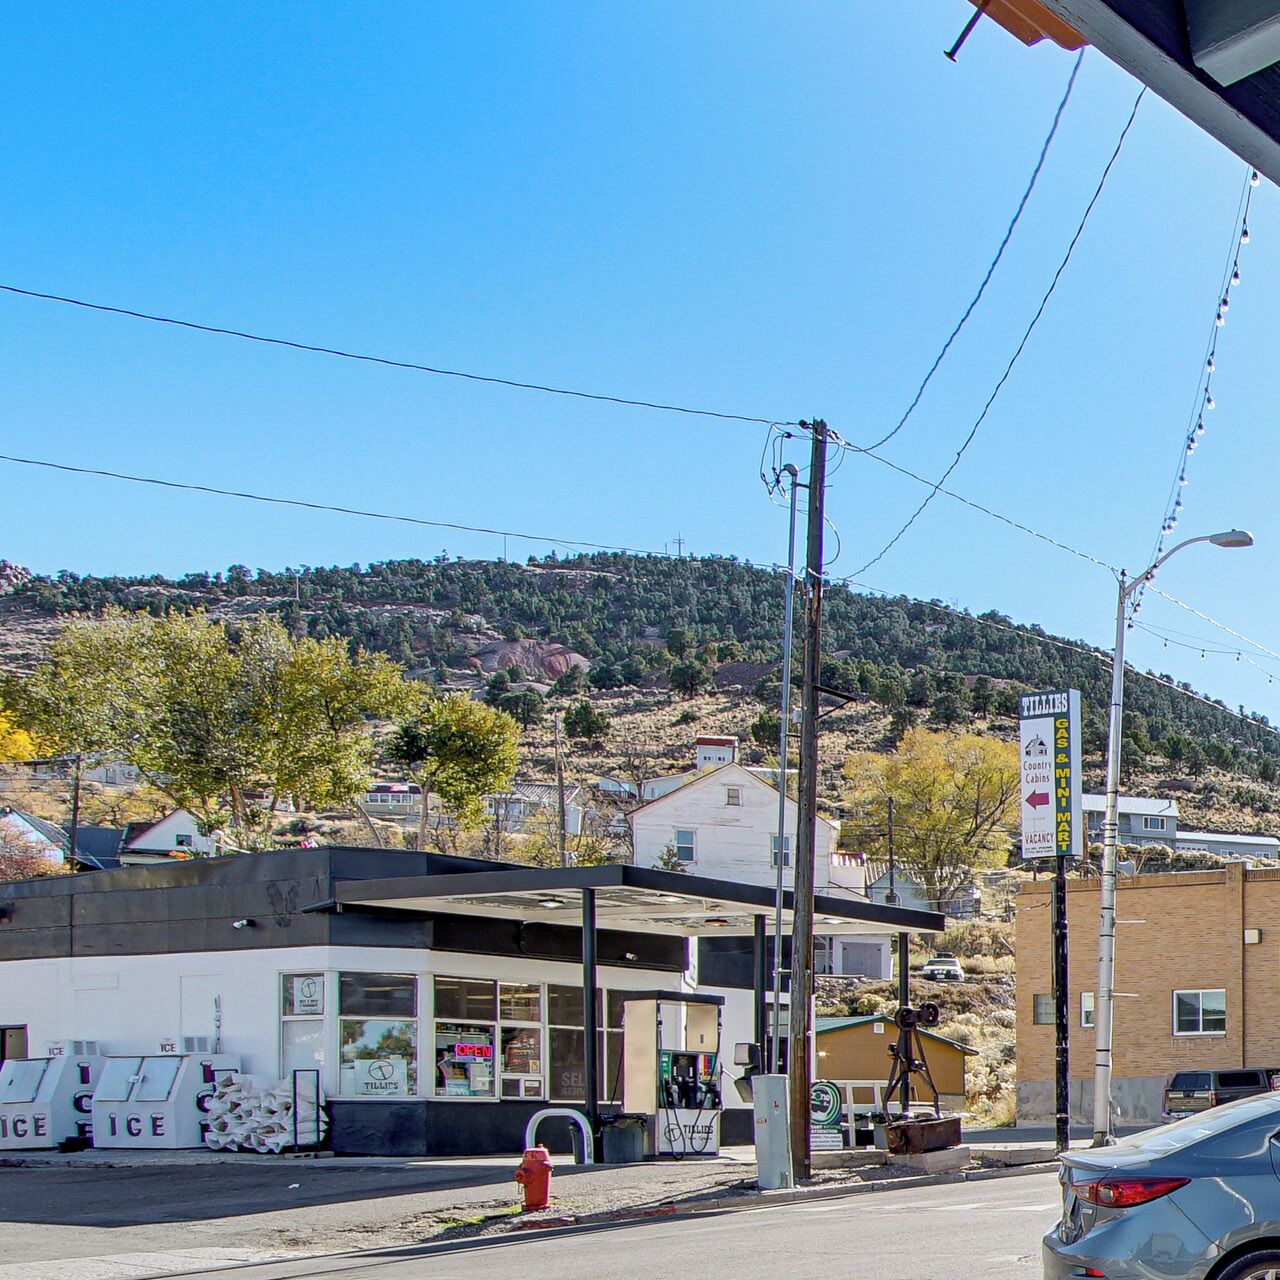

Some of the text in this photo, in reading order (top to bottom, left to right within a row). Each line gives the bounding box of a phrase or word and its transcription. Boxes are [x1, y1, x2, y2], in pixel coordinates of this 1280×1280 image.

[1022, 693, 1068, 716] TILLIES
[1023, 760, 1052, 772] Country
[1025, 773, 1050, 784] Cabins
[1055, 719, 1071, 851] GAS & MINI MART
[1025, 832, 1054, 845] VACANCY
[48, 1047, 64, 1056] ICE
[160, 1044, 176, 1052] ICE
[457, 1045, 492, 1057] OPEN
[561, 1072, 585, 1086] SEL
[0, 1112, 46, 1138] ICE
[109, 1112, 166, 1137] ICE
[683, 1124, 714, 1134] TILLIES
